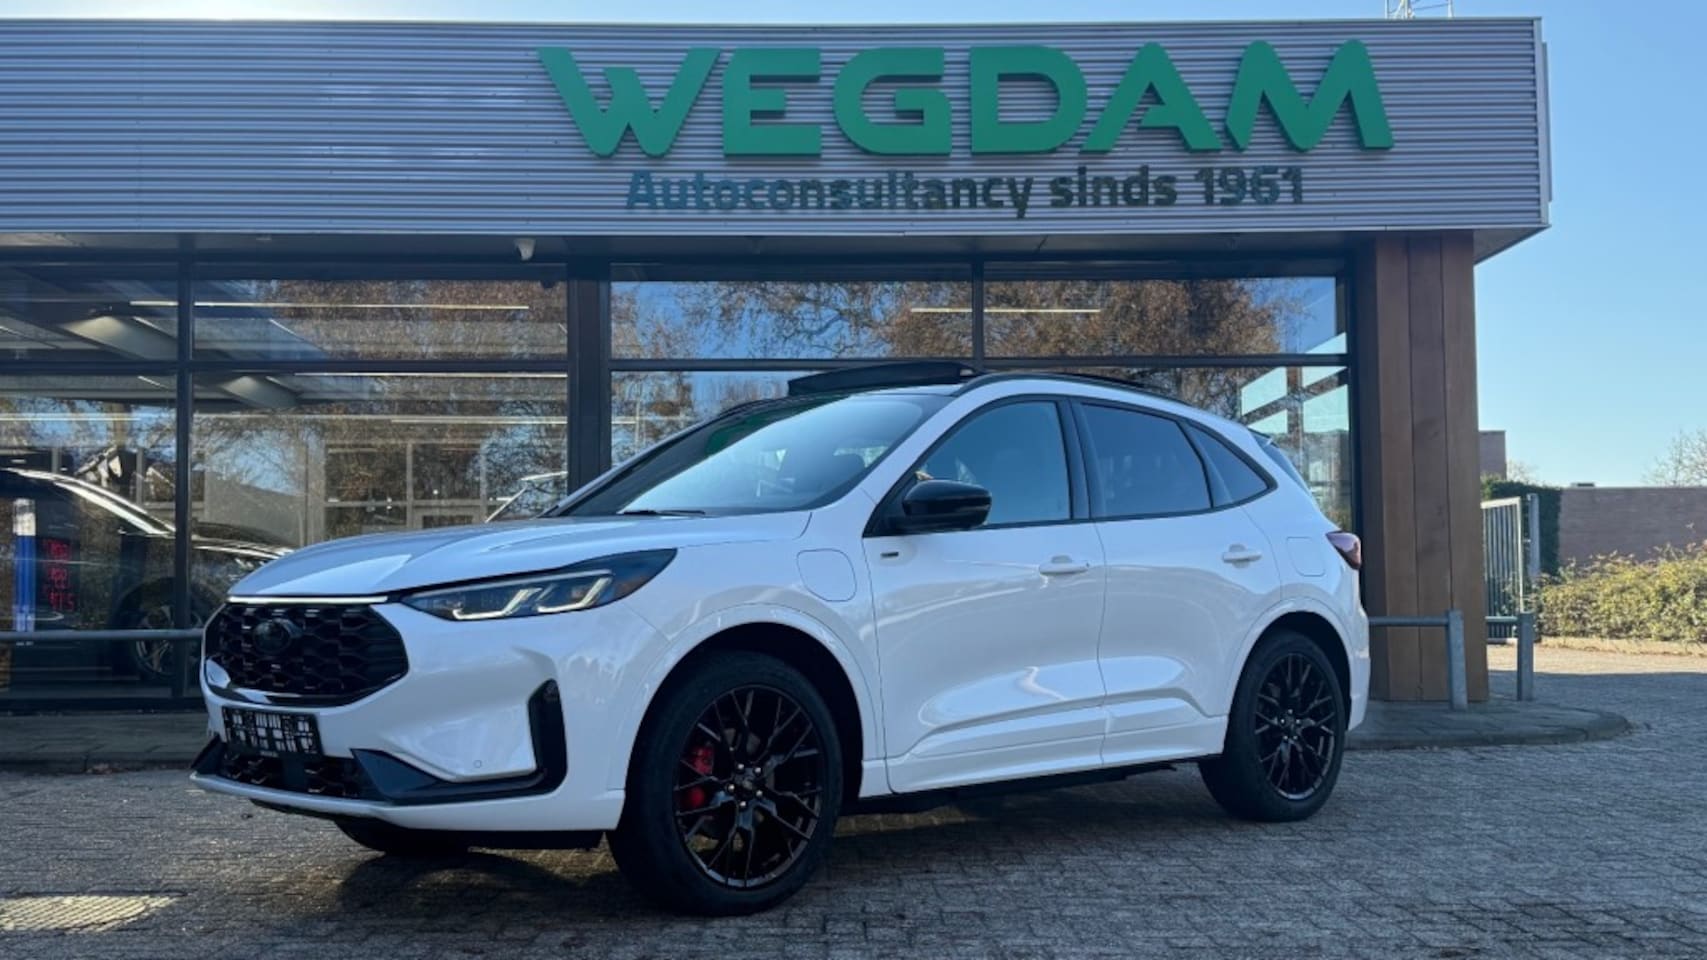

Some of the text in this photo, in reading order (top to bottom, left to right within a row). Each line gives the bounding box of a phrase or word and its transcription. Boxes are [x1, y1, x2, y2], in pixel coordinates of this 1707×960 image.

[538, 41, 1394, 157] WEGDAM
[627, 165, 1303, 218] Autoconsultancy sinds 1961
